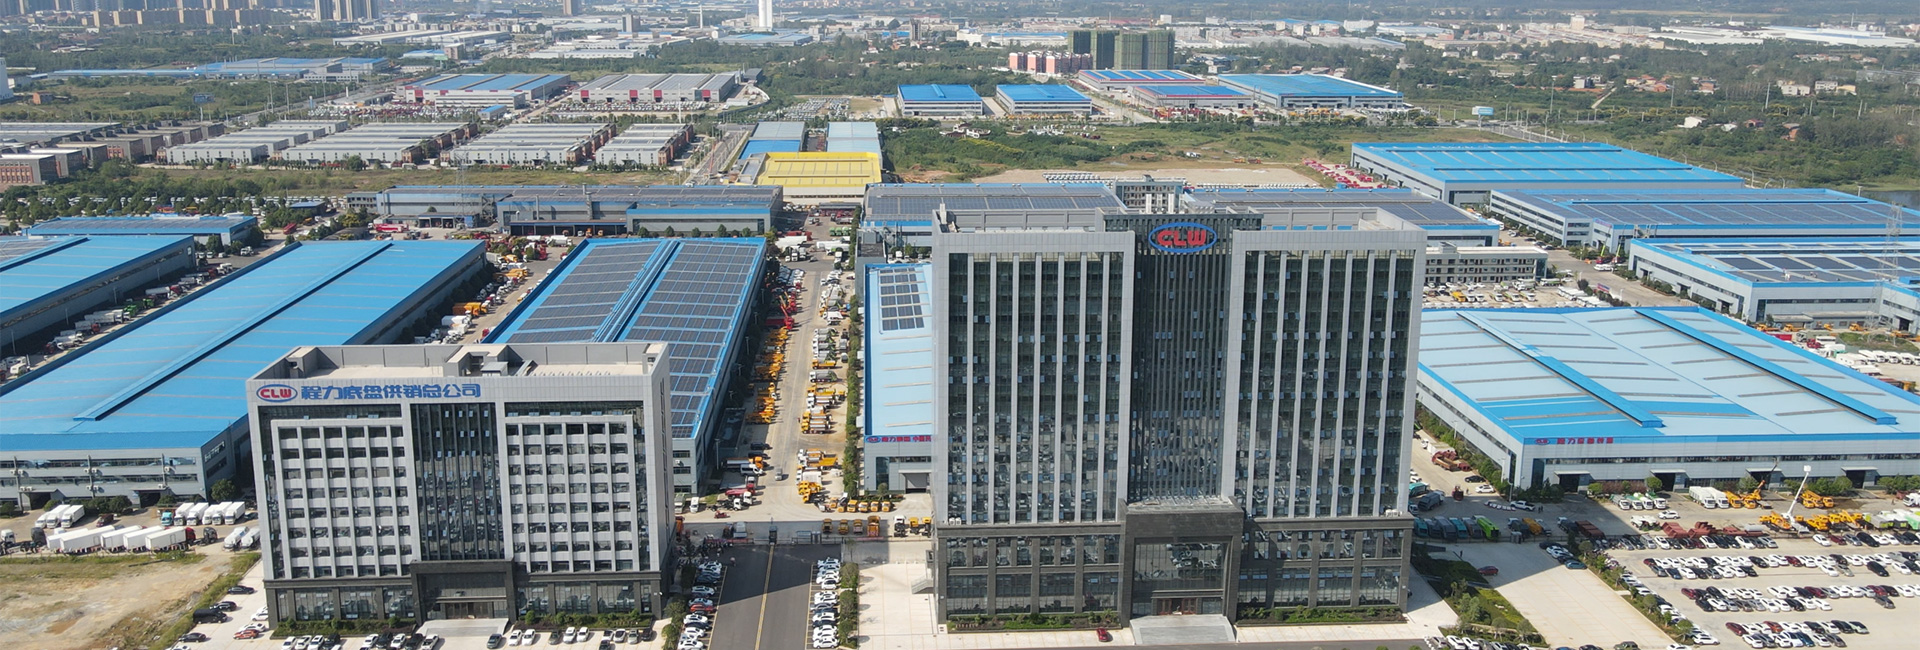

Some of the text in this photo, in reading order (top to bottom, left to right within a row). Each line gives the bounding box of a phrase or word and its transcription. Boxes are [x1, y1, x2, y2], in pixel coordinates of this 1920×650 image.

[1157, 230, 1207, 246] CLW
[259, 383, 481, 400] CLW 程力底盘供销总公司
